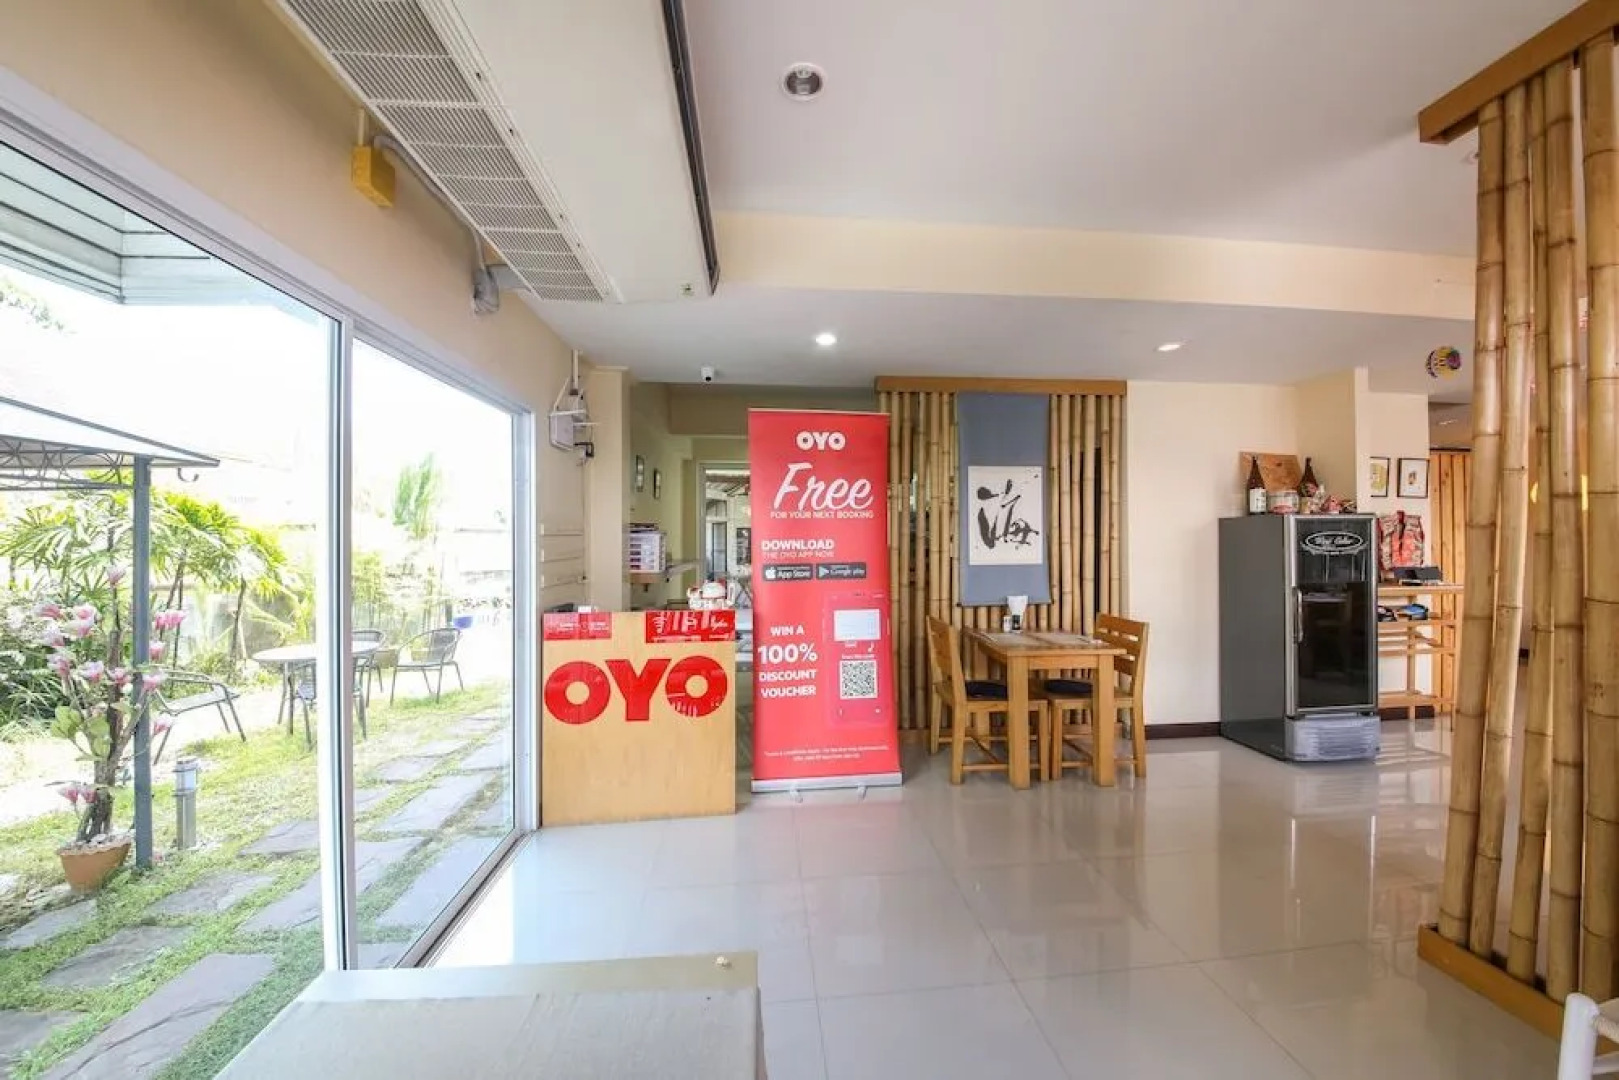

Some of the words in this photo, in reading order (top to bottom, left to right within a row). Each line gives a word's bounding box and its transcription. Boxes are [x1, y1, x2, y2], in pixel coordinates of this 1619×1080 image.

[796, 431, 846, 451] OYO
[773, 462, 874, 511] Free
[770, 510, 787, 519] FOR
[788, 510, 812, 519] YOUR
[812, 510, 836, 519] NEXT
[837, 510, 874, 519] BOOKING
[761, 539, 835, 550] DOWNLOAD
[777, 569, 793, 579] App
[794, 569, 811, 578] Store
[830, 568, 851, 578] Google
[770, 625, 794, 636] WIN
[796, 624, 804, 635] A
[757, 642, 818, 665] 100%
[758, 669, 818, 682] DISCOUNT
[544, 655, 728, 725] OYO
[760, 685, 817, 699] VOUCHER
